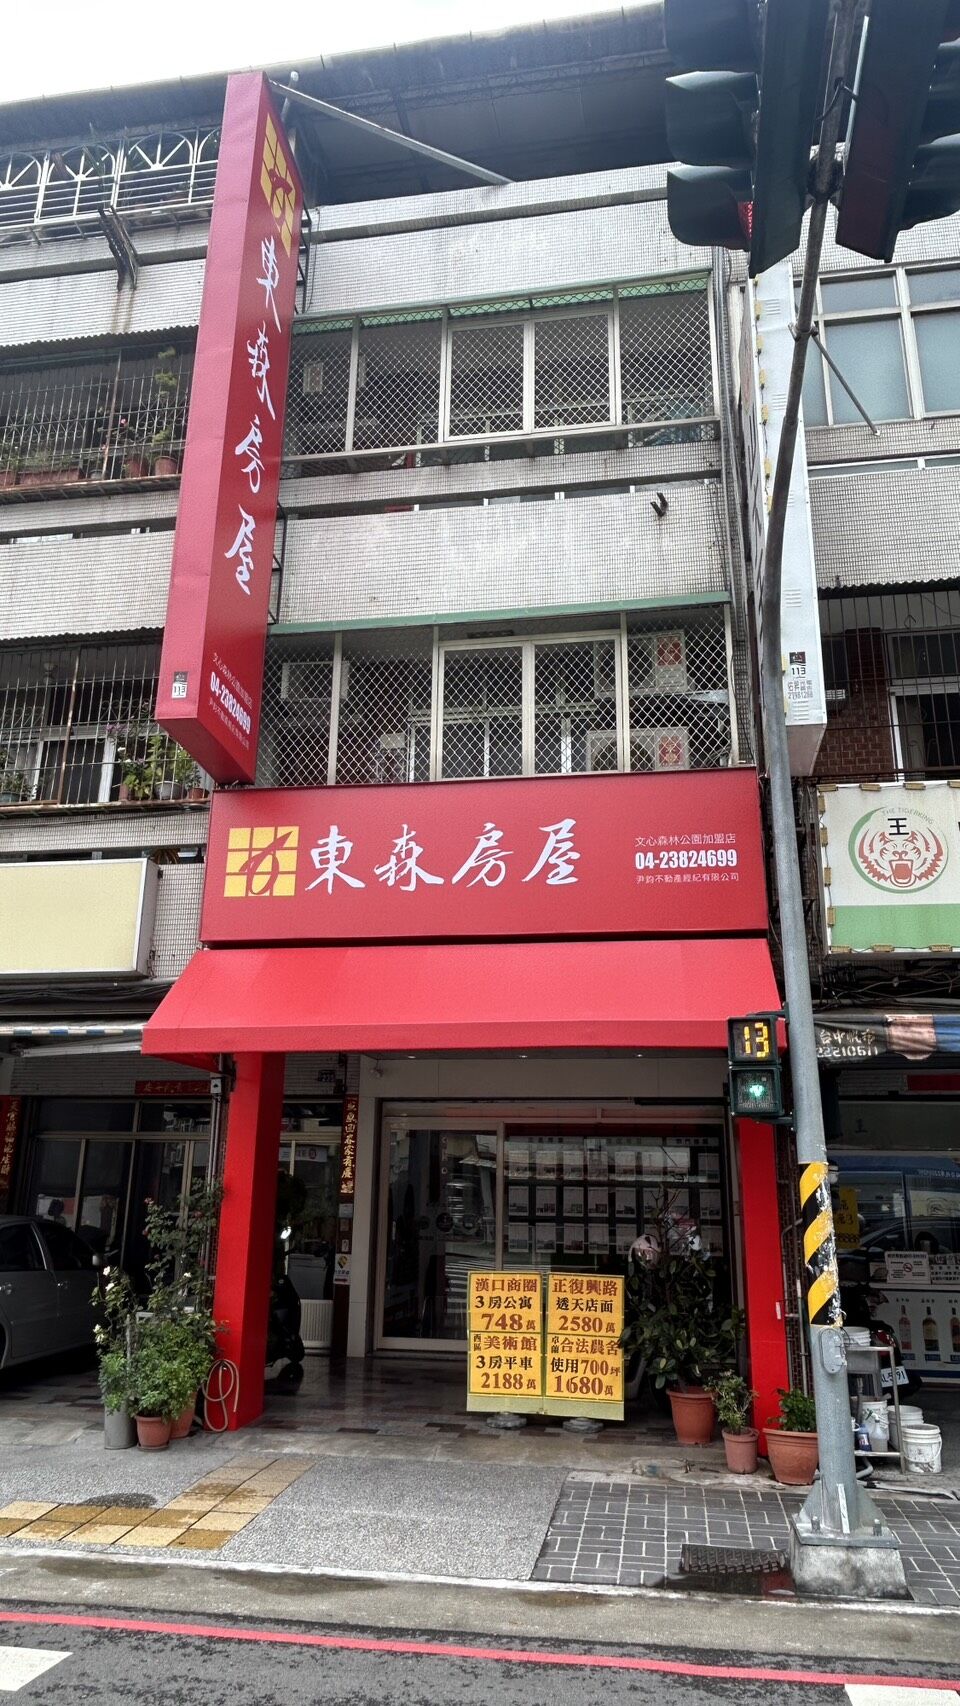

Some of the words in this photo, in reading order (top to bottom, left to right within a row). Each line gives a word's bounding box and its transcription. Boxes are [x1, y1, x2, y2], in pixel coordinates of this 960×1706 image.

[225, 235, 282, 595] 東森房屋
[792, 667, 806, 675] 113
[210, 671, 251, 735] 04-23824699
[635, 833, 736, 847] 文心森林公園加盟店
[304, 817, 582, 895] 東森房屋
[635, 849, 737, 869] 04-23824699
[743, 1022, 769, 1058] 13
[475, 1278, 537, 1292] 漢口商圈
[552, 1278, 617, 1296] 正復興路
[475, 1295, 532, 1309] 3房公寓
[556, 1297, 613, 1313] 透天店面
[484, 1336, 537, 1351] 美術館
[561, 1337, 620, 1355] 合法農舍
[476, 1355, 533, 1370] 3房平車
